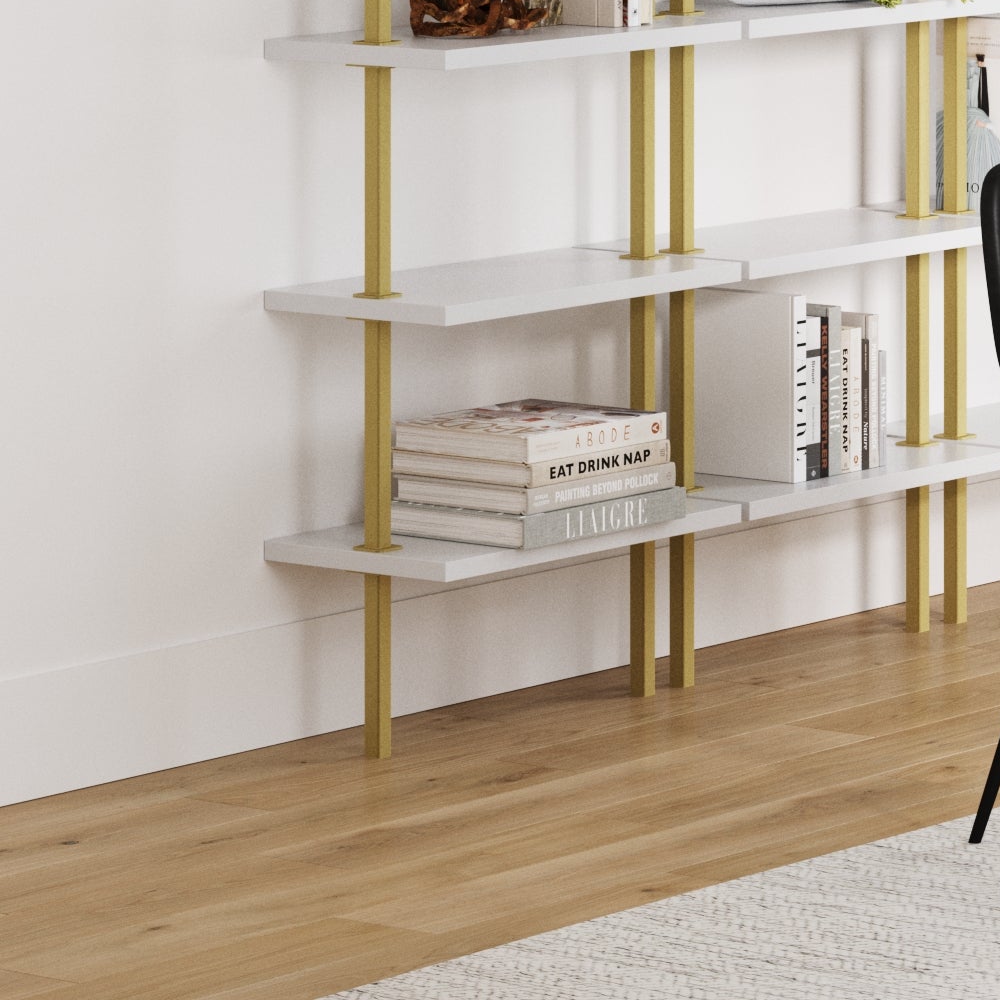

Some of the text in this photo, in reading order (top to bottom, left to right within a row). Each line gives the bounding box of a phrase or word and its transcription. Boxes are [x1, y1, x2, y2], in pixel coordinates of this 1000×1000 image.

[820, 326, 829, 470] KELLY WEARSTLER
[575, 424, 631, 449] ABODE
[549, 463, 574, 480] EAT
[578, 454, 620, 475] DRINK
[623, 449, 651, 466] NAP
[554, 486, 591, 504] PAINTING
[592, 480, 623, 498] BEYOND
[624, 472, 659, 489] POLLOCK
[565, 497, 648, 539] LIAIGRE
